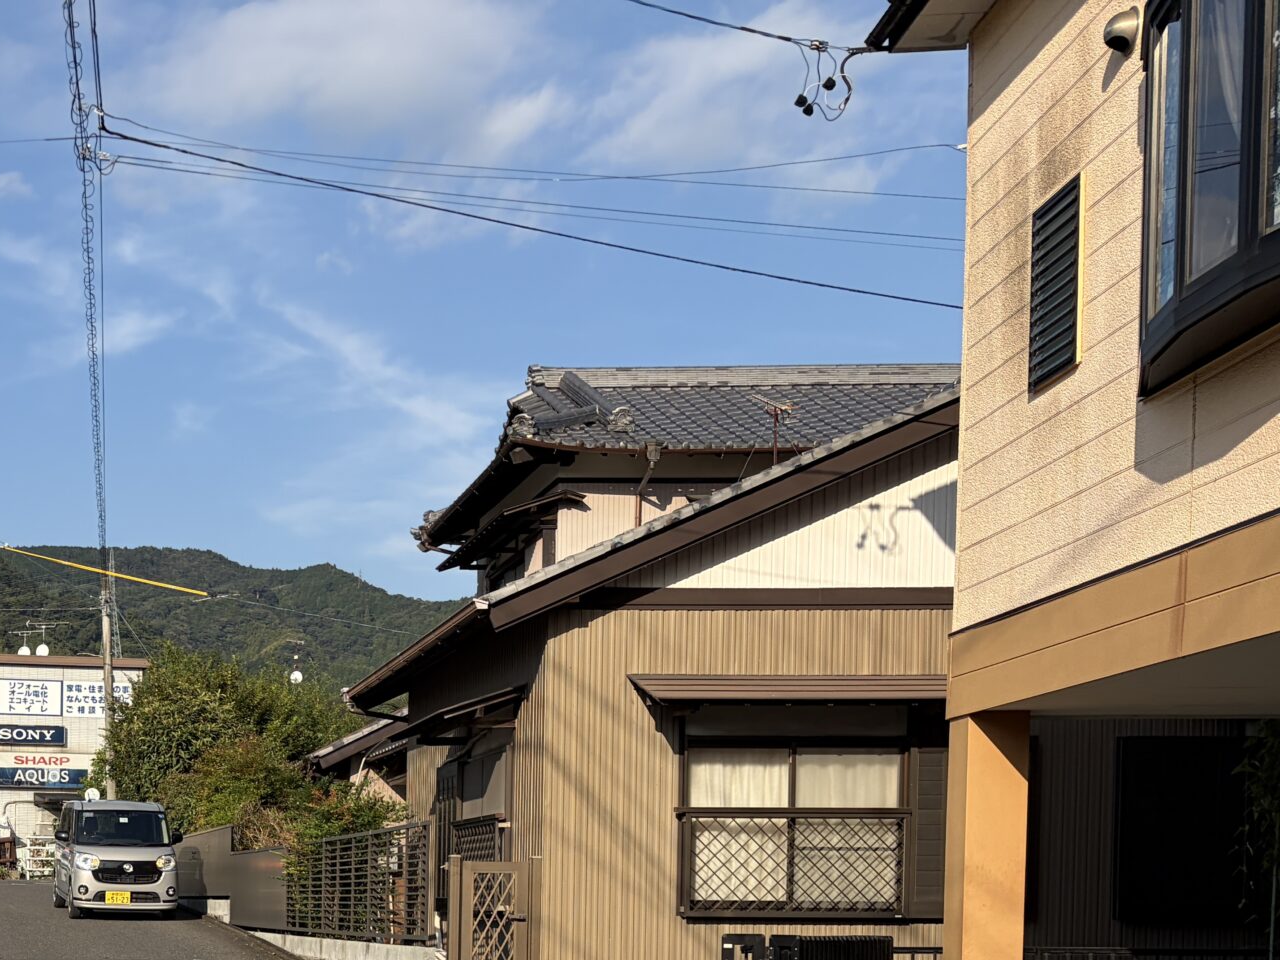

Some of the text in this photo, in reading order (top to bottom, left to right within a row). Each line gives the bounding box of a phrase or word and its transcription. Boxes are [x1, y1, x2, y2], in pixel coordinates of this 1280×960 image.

[8, 681, 48, 690] リフォーム
[66, 684, 130, 693] 家電・住まの事
[8, 690, 49, 698] オール電化
[8, 698, 49, 706] エコキュート
[13, 756, 70, 765] SHARP
[14, 769, 69, 785] AQUOS
[110, 896, 129, 904] 51-23
